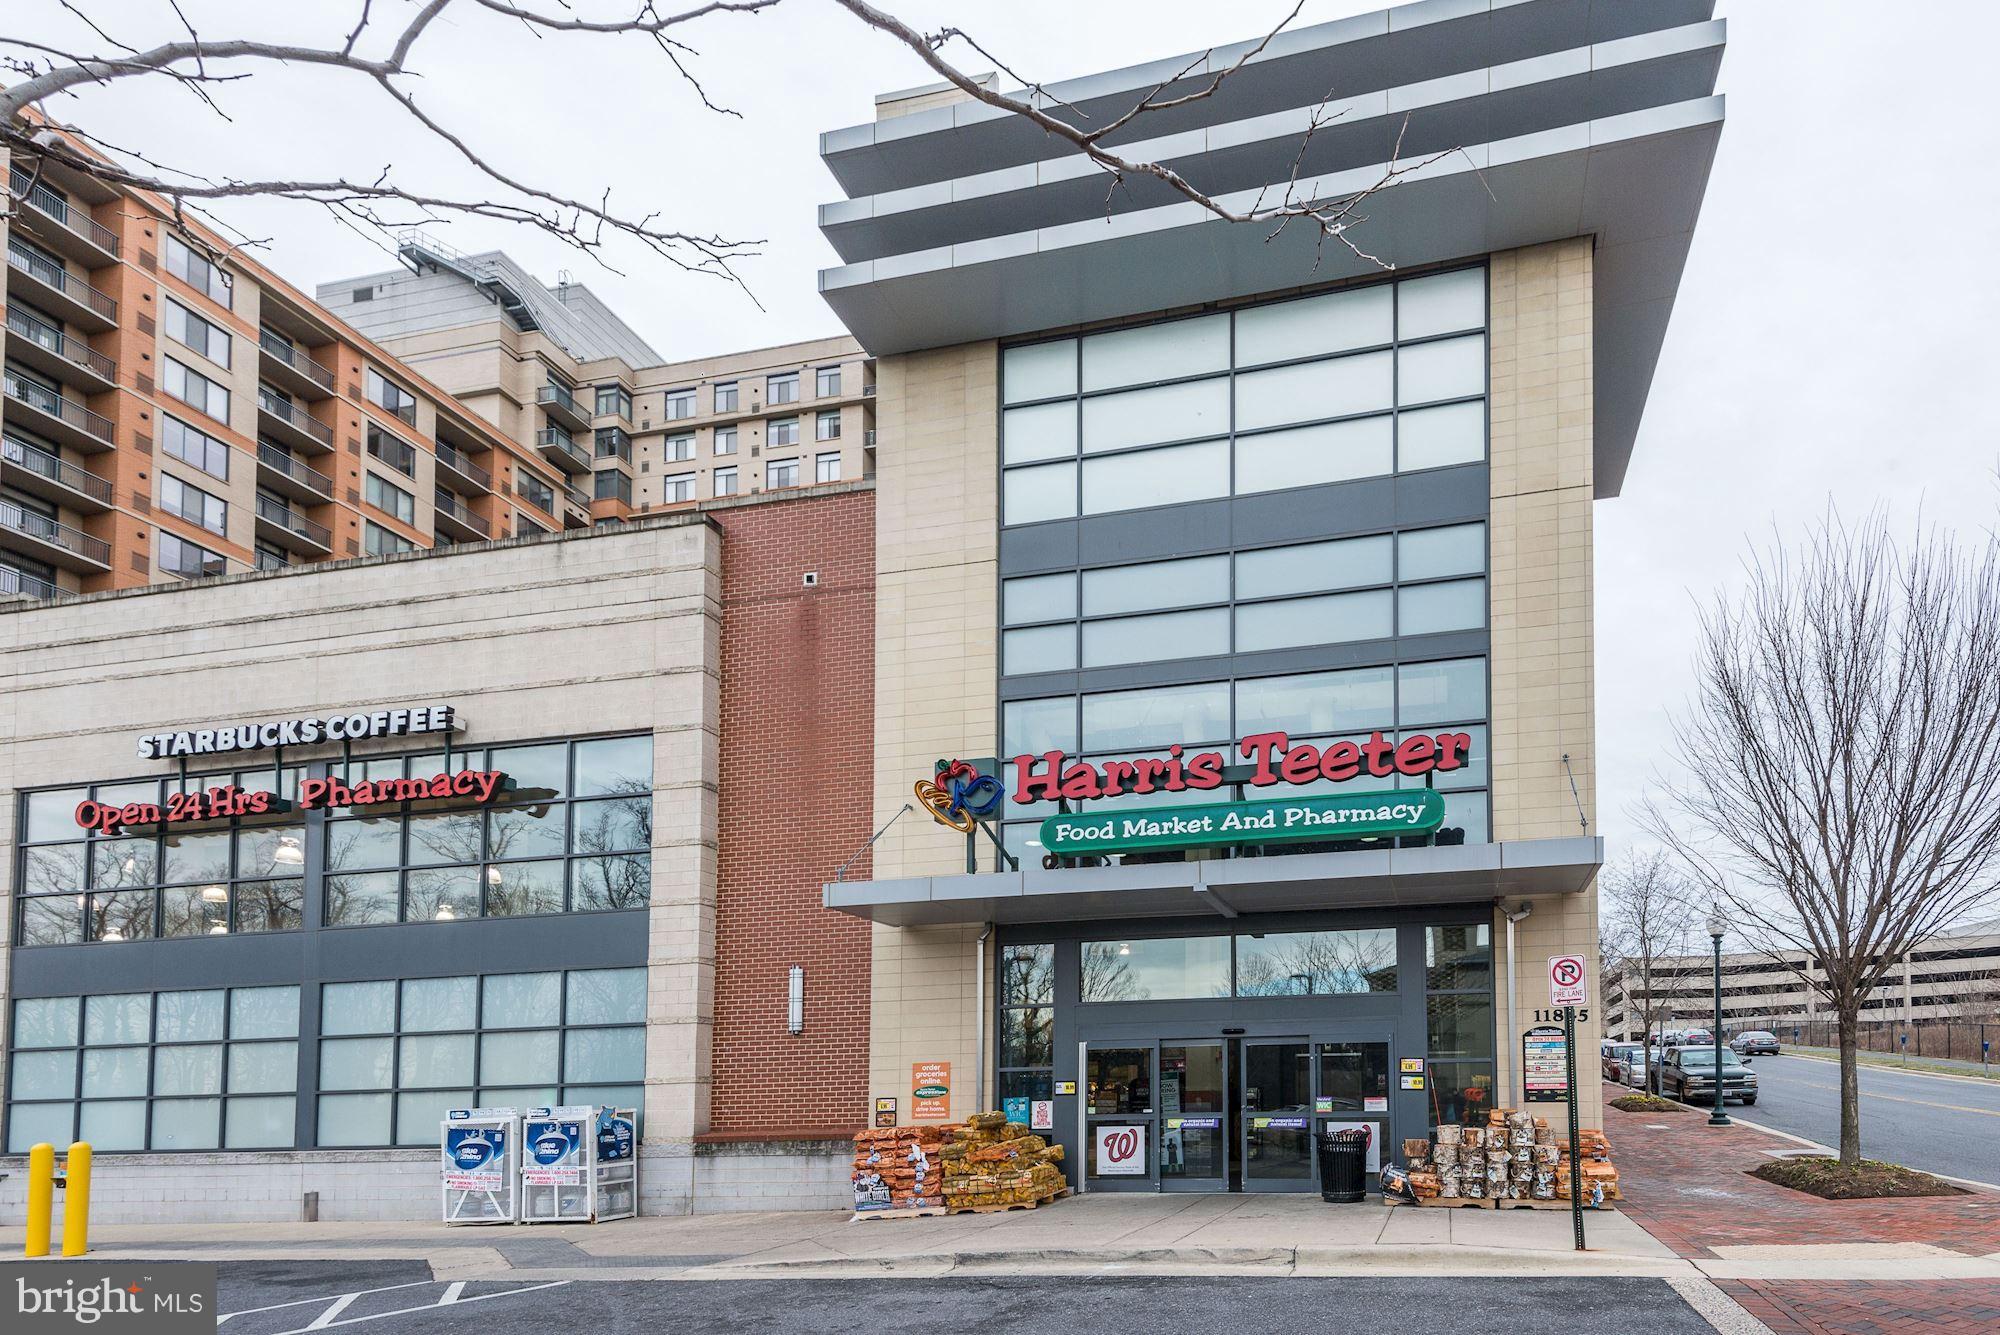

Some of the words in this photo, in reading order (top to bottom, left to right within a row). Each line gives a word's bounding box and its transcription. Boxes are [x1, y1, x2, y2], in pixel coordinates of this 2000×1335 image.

[137, 718, 319, 760] STARBUCKS
[326, 705, 450, 740] COFFEE
[1012, 743, 1224, 804] Harris
[1240, 730, 1471, 787] Teeter
[75, 799, 161, 836] Open
[166, 792, 202, 823] 24
[208, 784, 270, 818] Hrs
[300, 769, 501, 810] Pharmacy
[1055, 820, 1116, 842] Food
[1122, 815, 1213, 839] Market
[1219, 808, 1277, 832] And
[1283, 803, 1427, 828] Pharmacy
[1567, 989, 1584, 997] LANE
[1533, 1009, 1589, 1023] 1185
[915, 1071, 947, 1080] groceries
[1104, 1128, 1138, 1163] W
